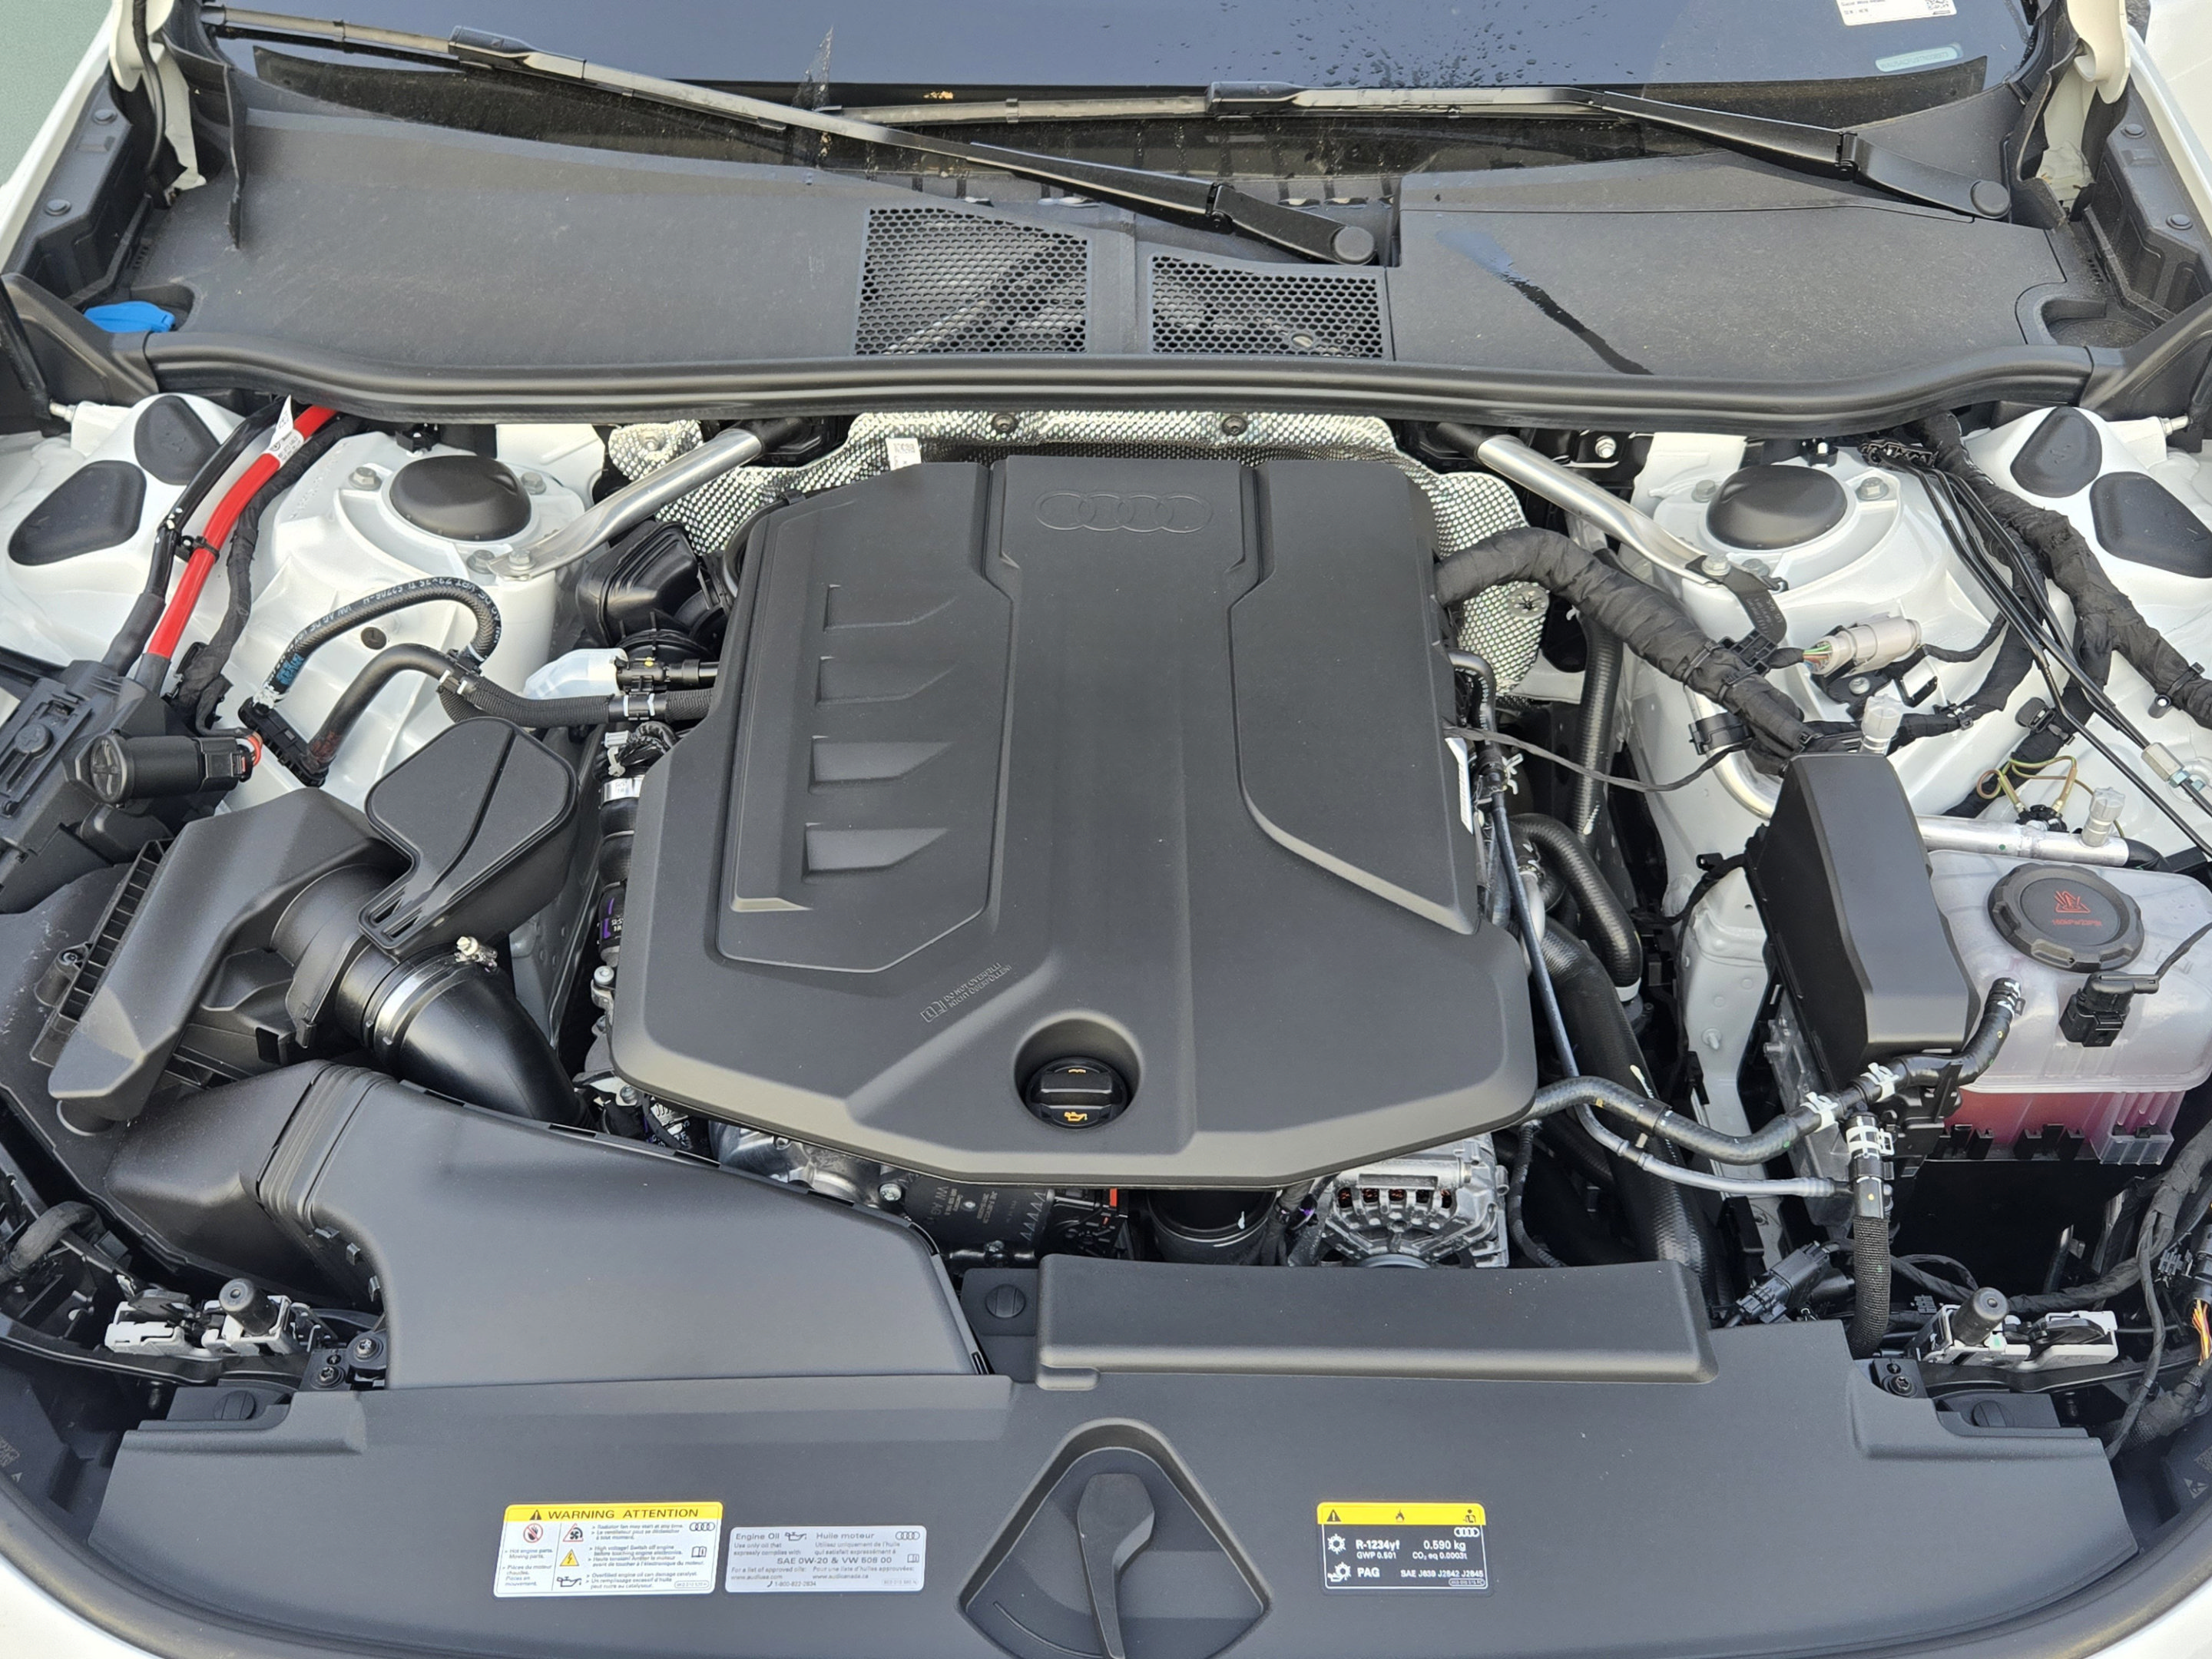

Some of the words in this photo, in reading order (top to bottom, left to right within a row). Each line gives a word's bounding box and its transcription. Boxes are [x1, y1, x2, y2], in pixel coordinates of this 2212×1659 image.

[548, 1509, 615, 1520] WARNING
[622, 1508, 699, 1518] ATTENTION
[735, 1533, 765, 1541] Engine
[1356, 1539, 1400, 1551] R-1234yf
[1453, 1539, 1467, 1551] kg
[1356, 1551, 1376, 1560] GWP
[1428, 1552, 1439, 1561] eq
[1357, 1567, 1381, 1578] PAG
[1400, 1569, 1417, 1578] SAE
